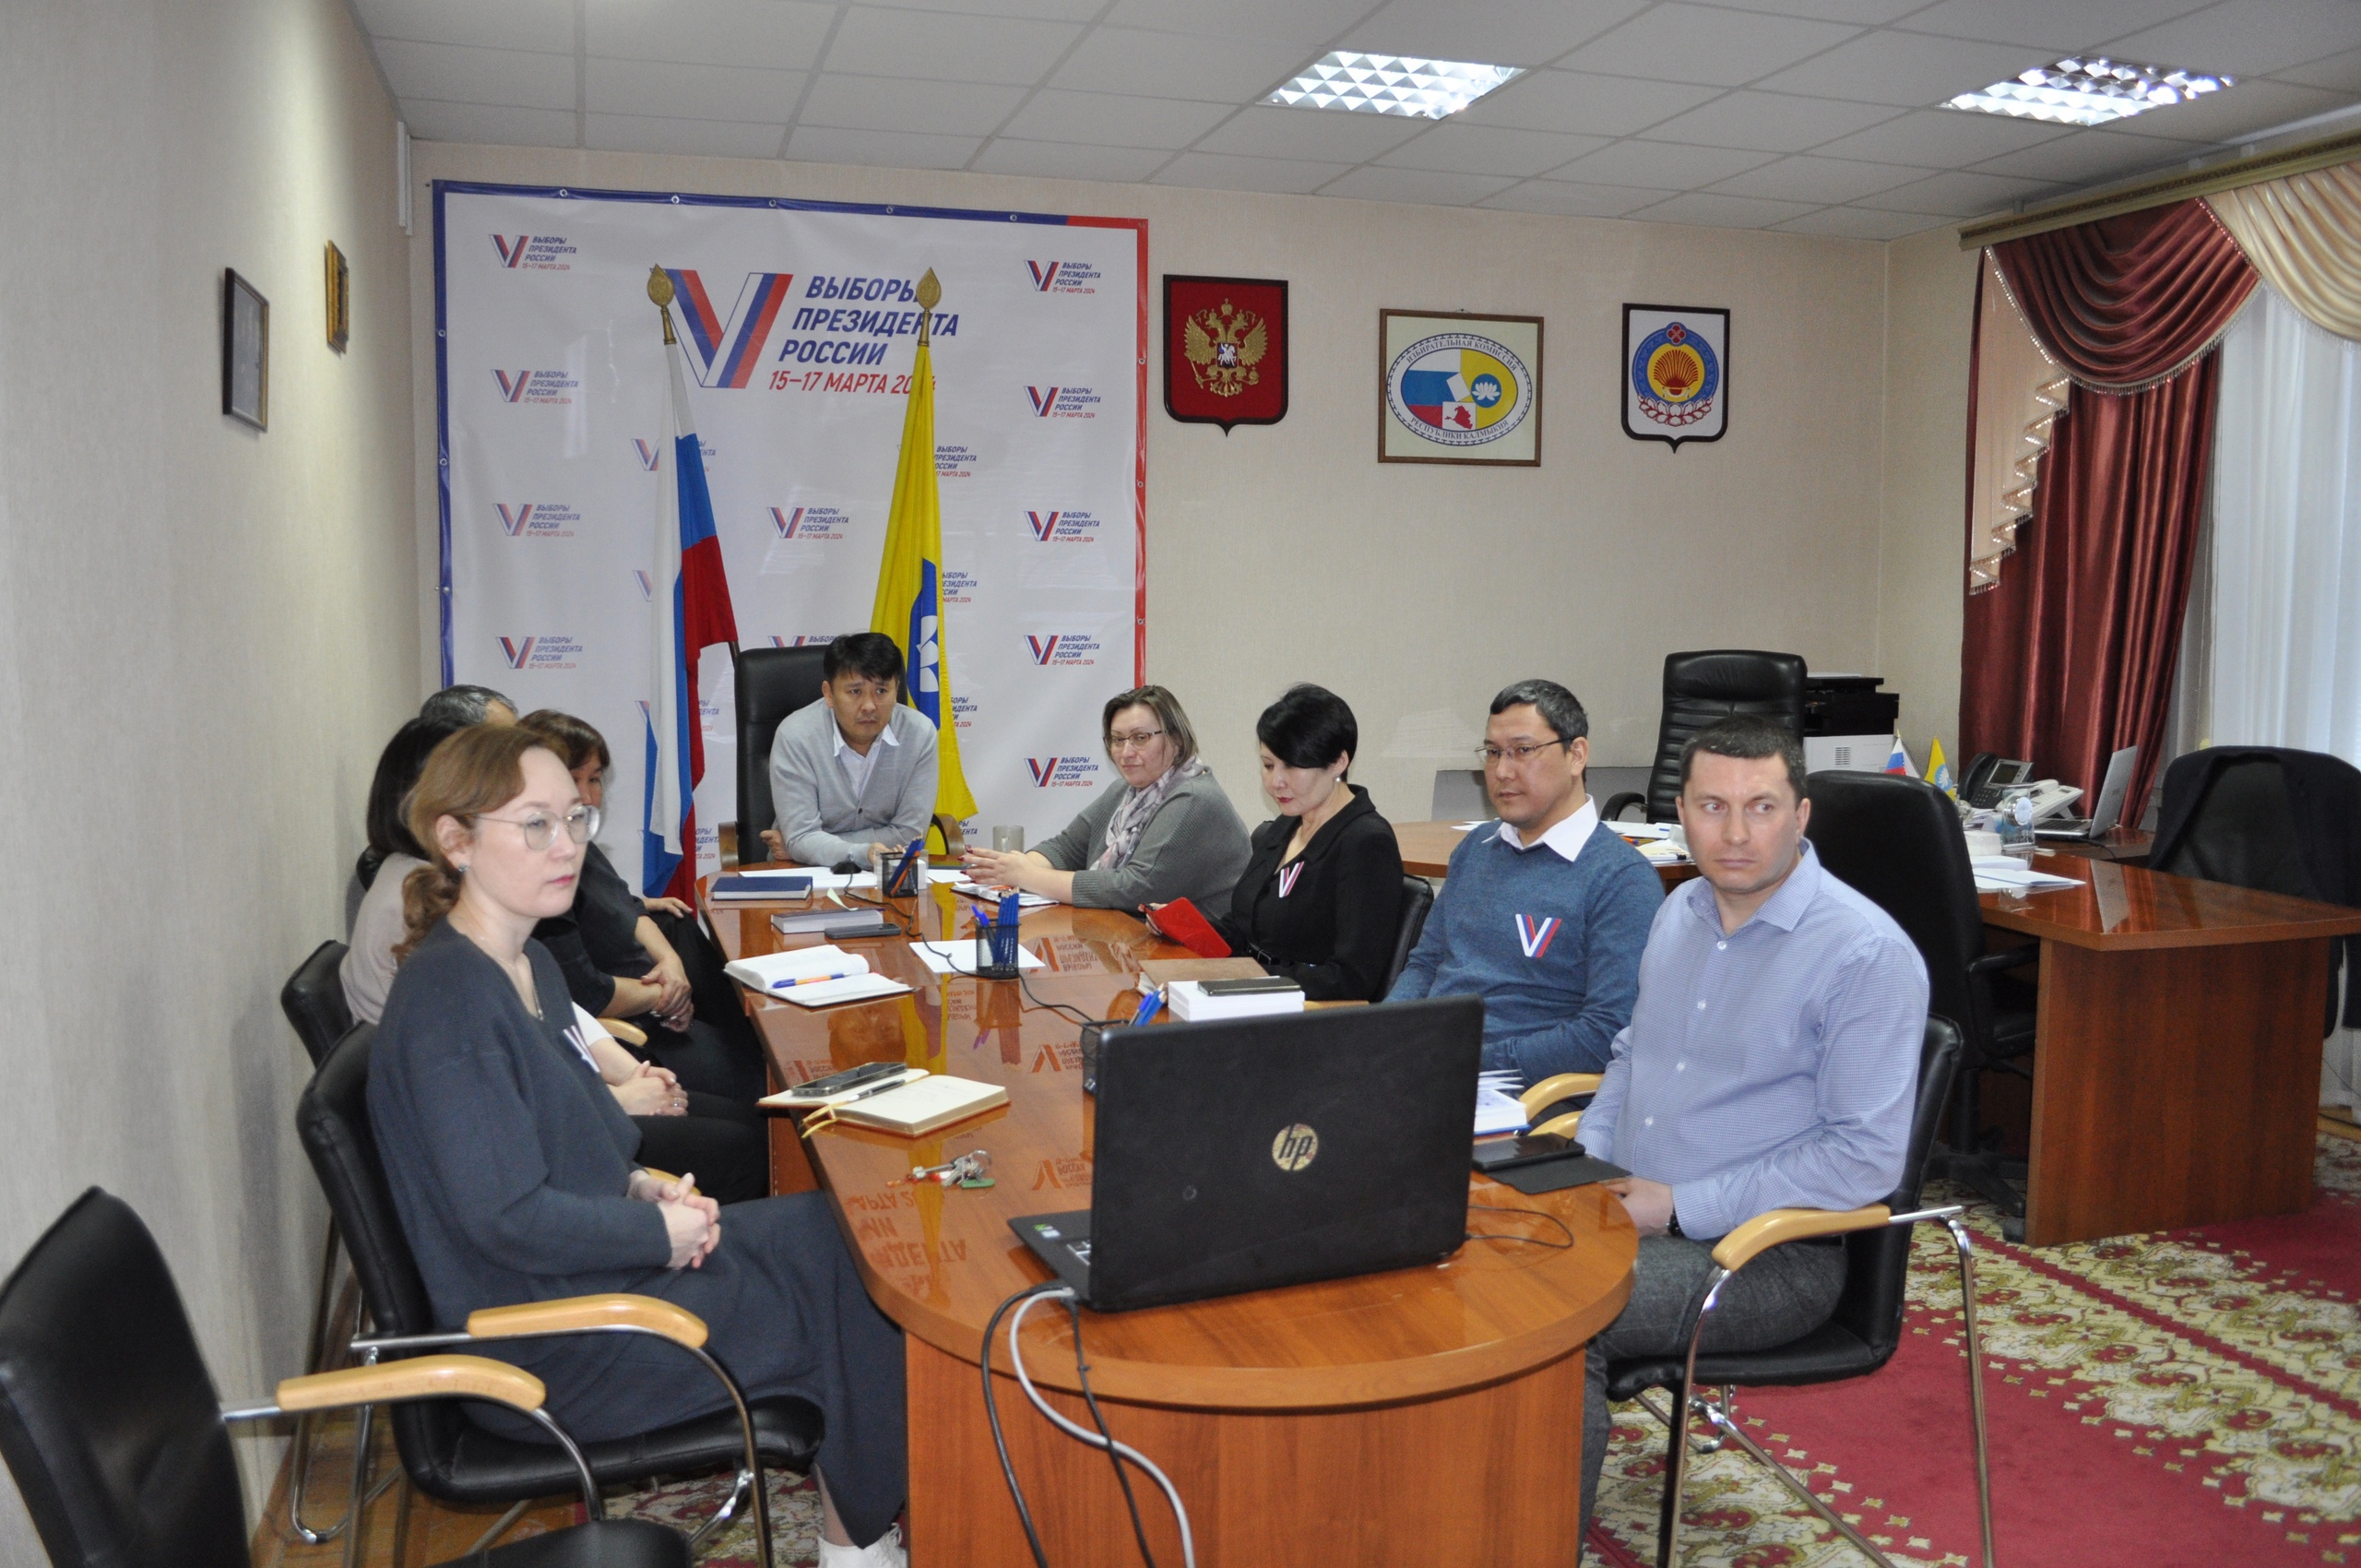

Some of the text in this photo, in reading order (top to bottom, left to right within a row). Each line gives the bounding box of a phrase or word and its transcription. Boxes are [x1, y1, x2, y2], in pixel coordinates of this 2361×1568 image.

[528, 245, 577, 254] ПРЕЗИДЕНТА
[532, 236, 566, 244] ВЫБОРЫ
[778, 339, 888, 365] РОССИИ
[1406, 339, 1518, 372] ИЗБИРАТЕЛЬНАЯ КОМИССИЯ
[823, 372, 887, 393] МАРТА
[1410, 417, 1462, 440] РЕСПУБЛИКИ
[1278, 1125, 1313, 1170] hp
